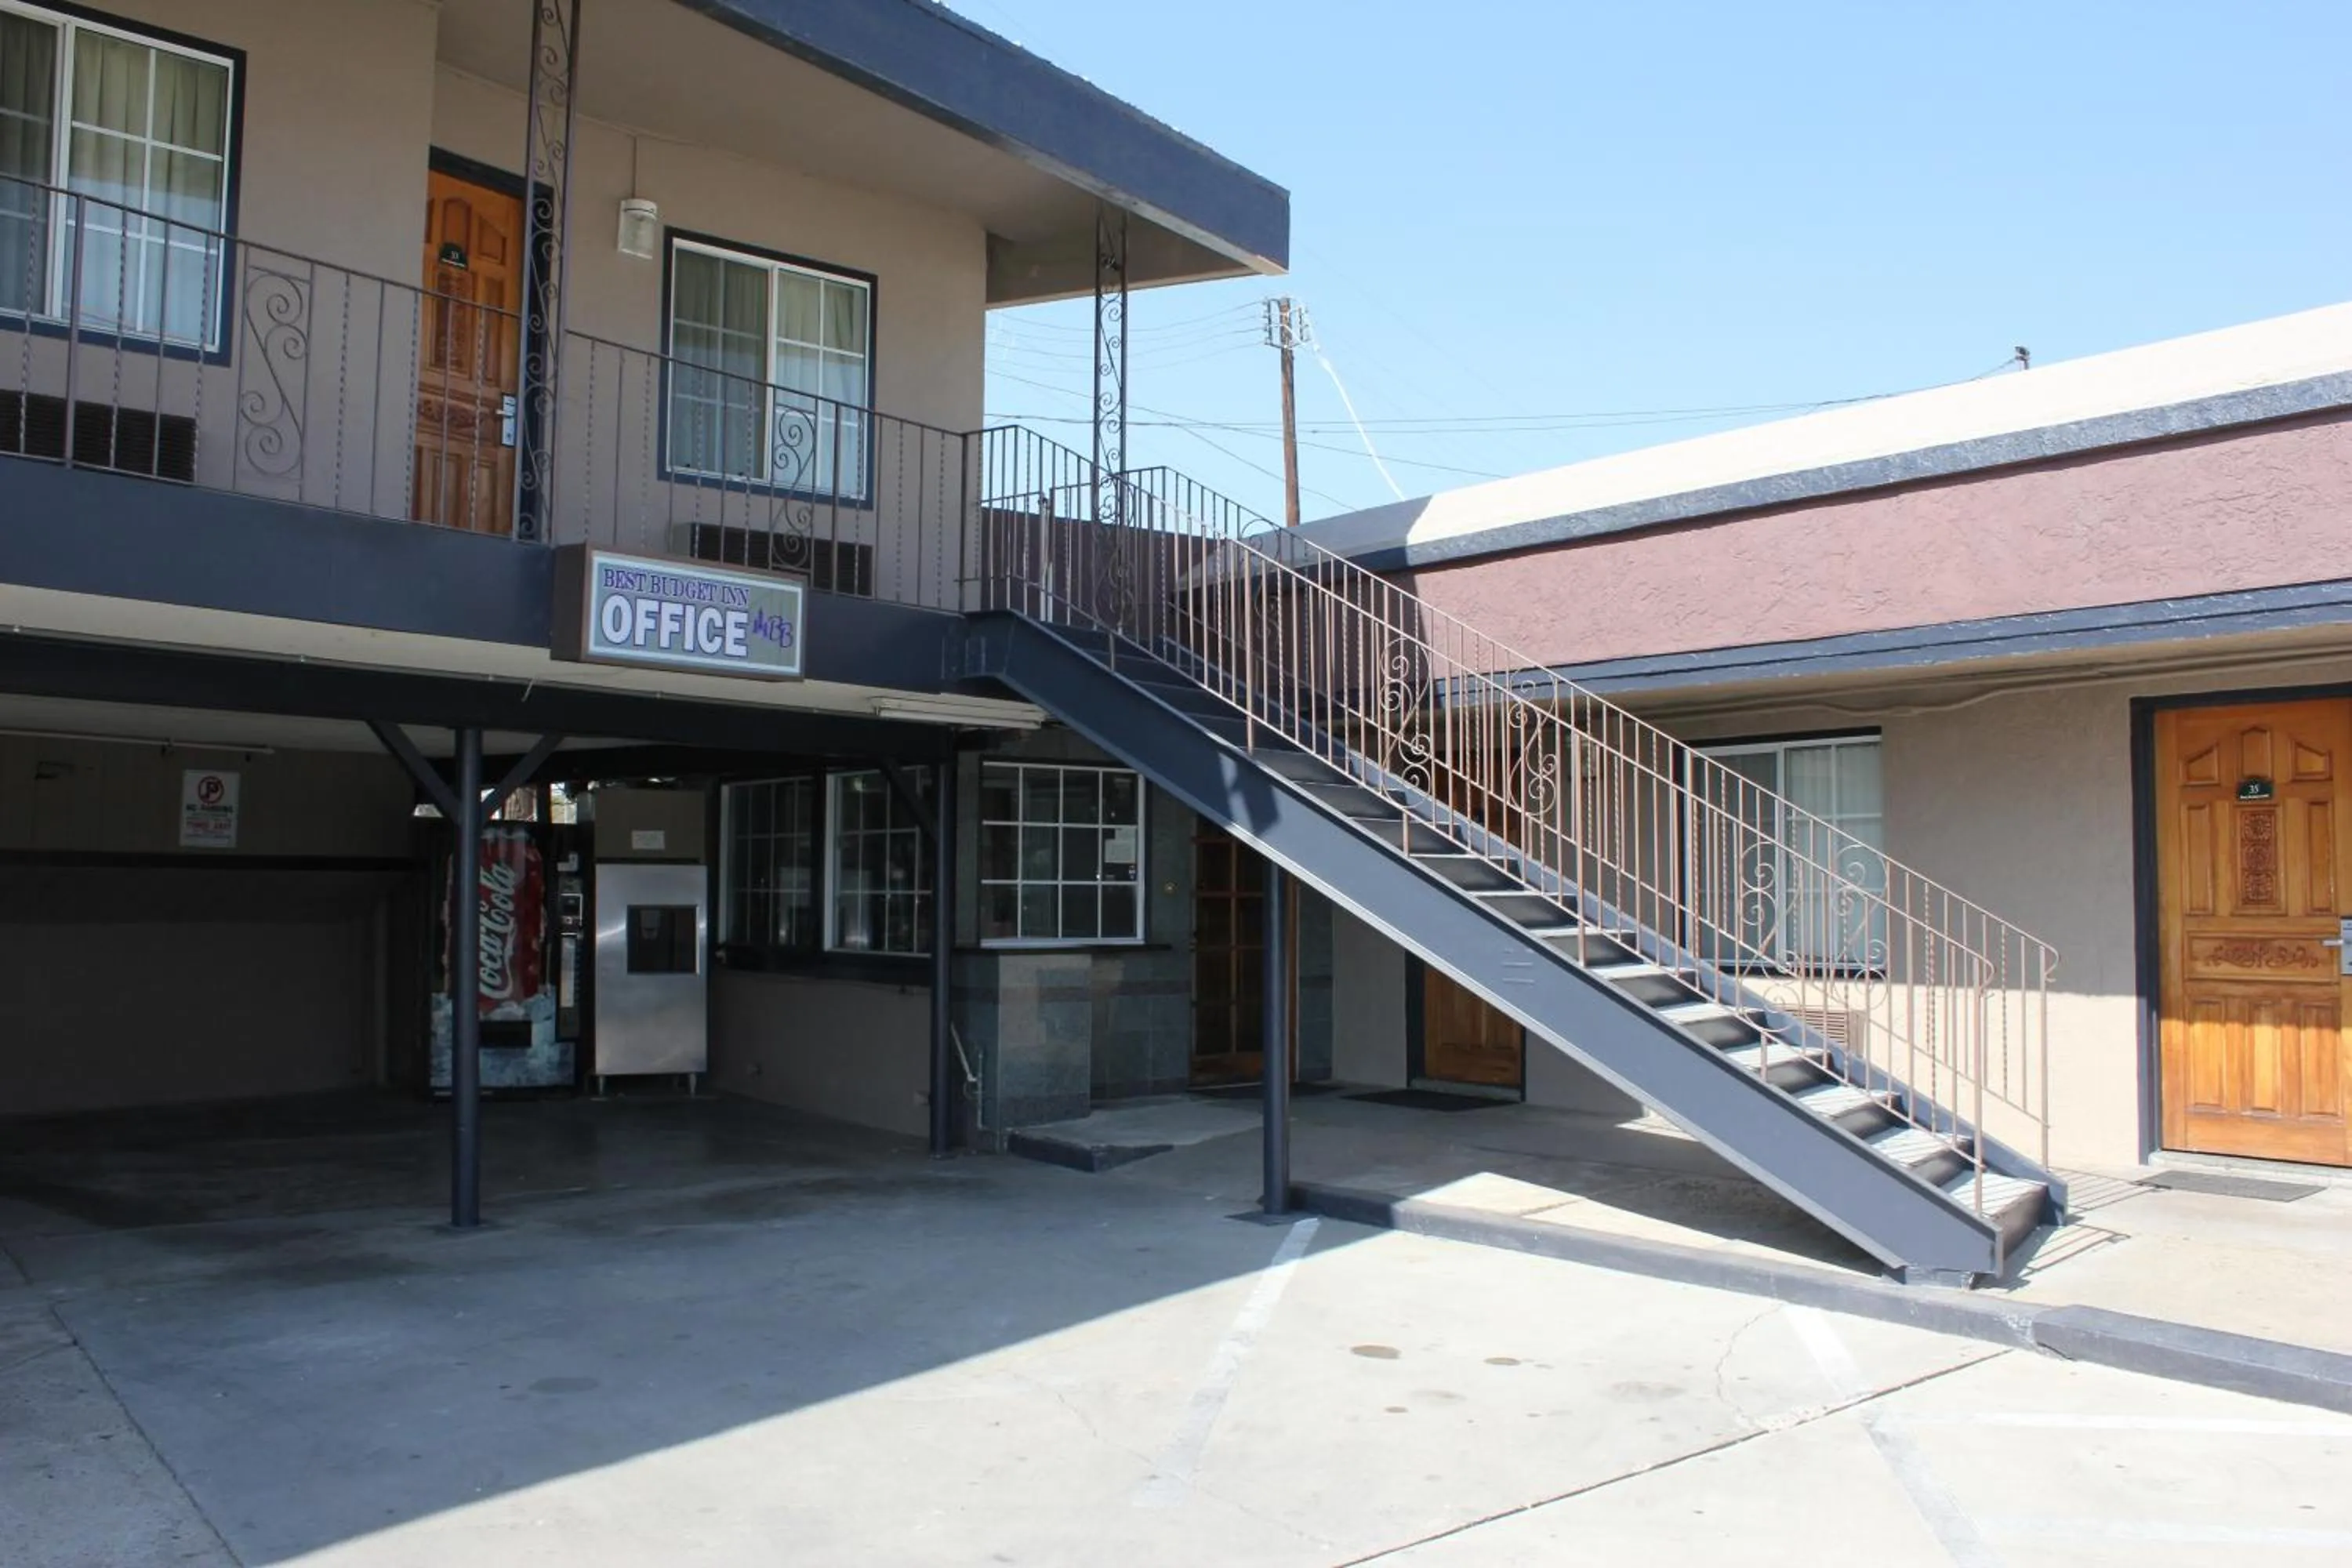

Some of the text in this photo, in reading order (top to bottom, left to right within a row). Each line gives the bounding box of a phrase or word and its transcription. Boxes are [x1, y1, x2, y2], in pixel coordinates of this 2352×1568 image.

[603, 568, 750, 606] BEST BUDGET INN
[601, 593, 749, 657] OFFICE
